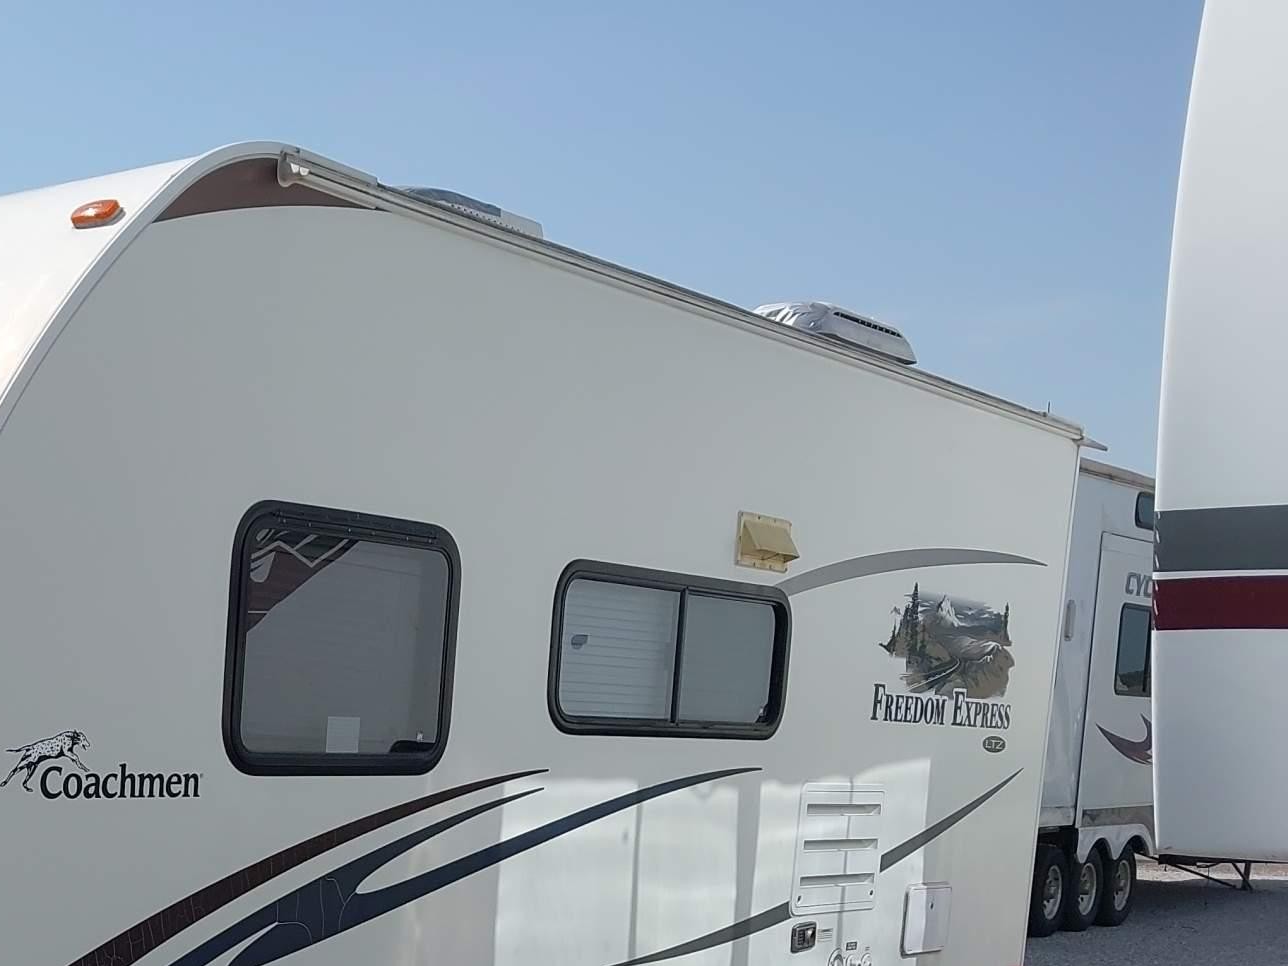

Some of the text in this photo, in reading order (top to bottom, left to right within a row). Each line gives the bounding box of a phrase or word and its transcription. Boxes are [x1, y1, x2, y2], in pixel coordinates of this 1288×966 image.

[870, 683, 1012, 730] FREEDOM EXPRESS
[985, 739, 1004, 750] LTZ
[40, 763, 201, 800] Coachmen
